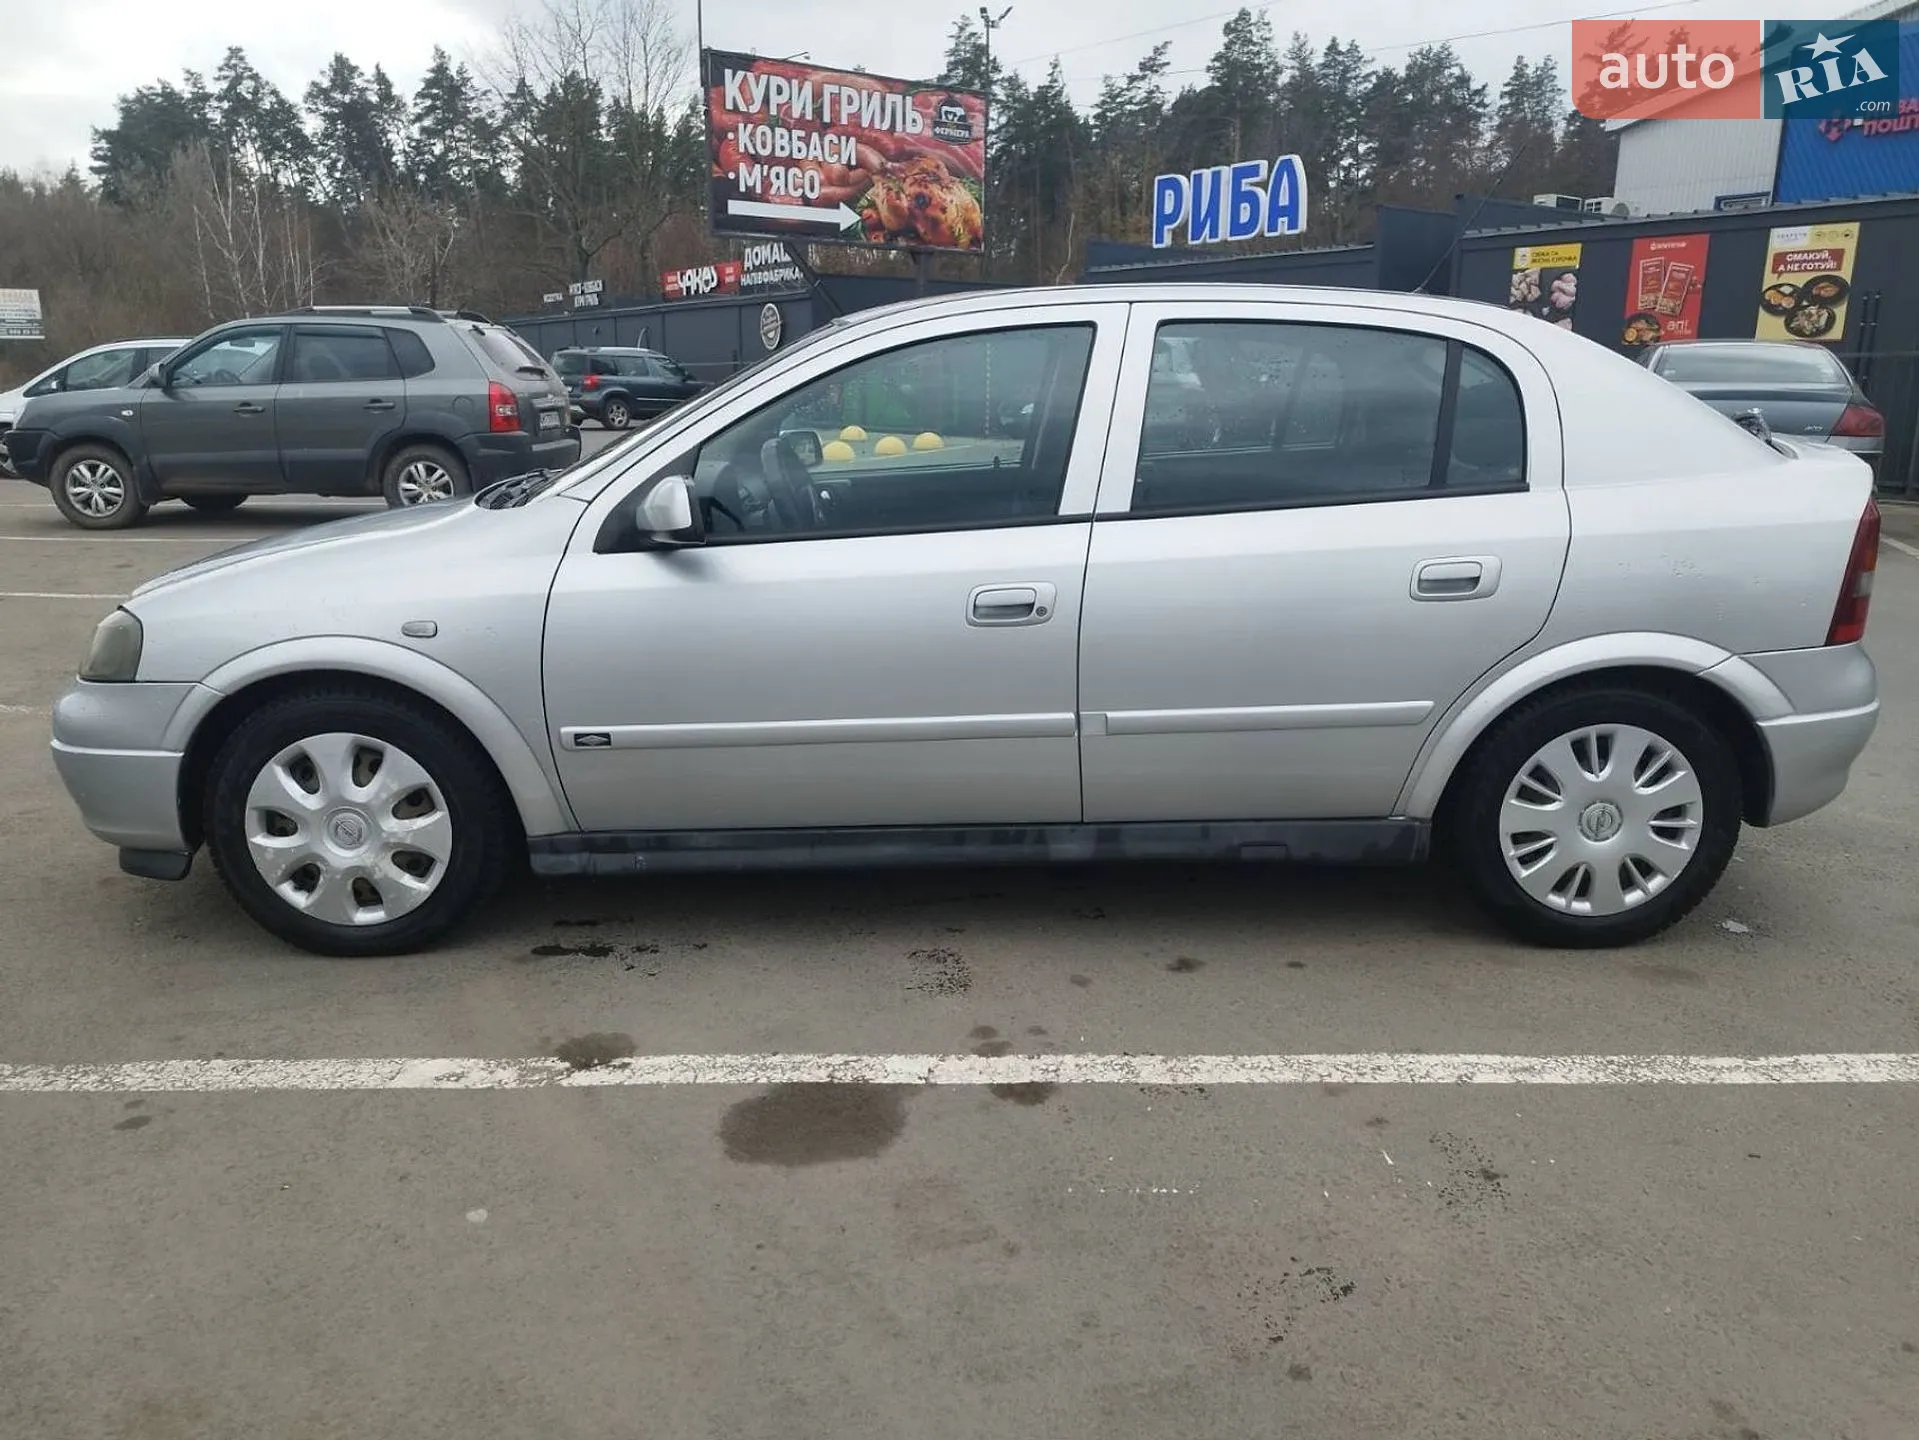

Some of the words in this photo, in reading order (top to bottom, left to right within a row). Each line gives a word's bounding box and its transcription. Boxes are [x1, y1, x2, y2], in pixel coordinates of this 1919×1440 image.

[724, 68, 813, 122] КУРИ
[822, 84, 925, 134] ГРИЛЬ
[738, 123, 857, 166] КОВБАСИ
[738, 163, 821, 199] М'ЯСО
[1152, 154, 1308, 249] РИБА
